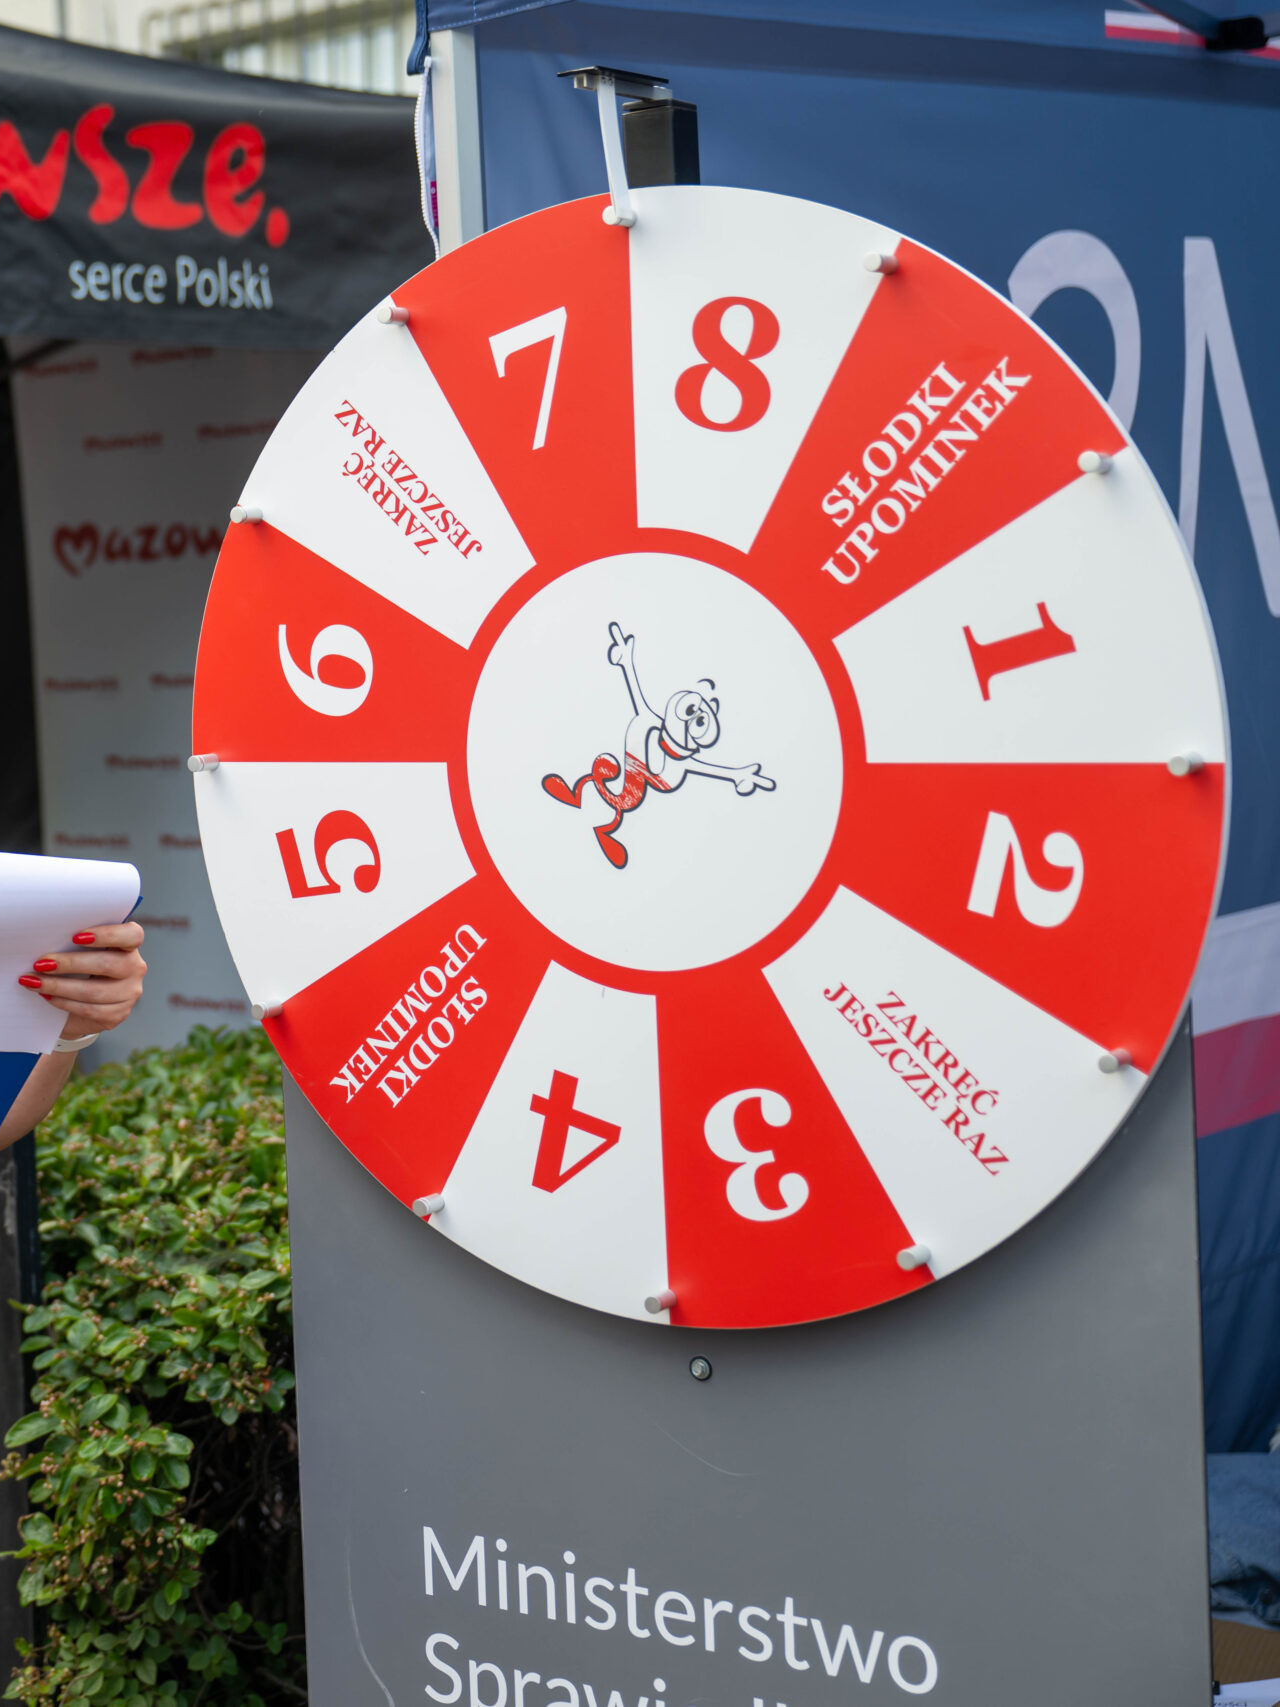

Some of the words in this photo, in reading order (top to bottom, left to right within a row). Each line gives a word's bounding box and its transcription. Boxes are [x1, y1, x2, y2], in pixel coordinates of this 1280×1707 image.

[69, 260, 168, 304] serce
[175, 254, 274, 310] Polski
[488, 306, 568, 451] 7
[674, 296, 780, 432] 8
[334, 399, 387, 458] RAZ
[820, 356, 1031, 585] UPOMINEK
[821, 361, 966, 528] SŁODKI
[53, 522, 222, 577] Mazow
[342, 452, 439, 556] ZAKRĘĆ
[381, 449, 483, 559] JESZCZE
[278, 624, 374, 717] 6
[963, 601, 1077, 702] 1
[275, 809, 381, 899] 5
[967, 810, 1084, 927] 2
[329, 923, 488, 1104] UPOMINEK
[376, 976, 488, 1108] SŁODKI
[876, 991, 1000, 1116] ZAKRĘĆ
[529, 1069, 622, 1194] 4
[823, 981, 945, 1111] JESZCZE
[941, 1106, 1010, 1176] RAZ
[703, 1088, 809, 1222] 3
[423, 1525, 939, 1695] Ministerstwo
